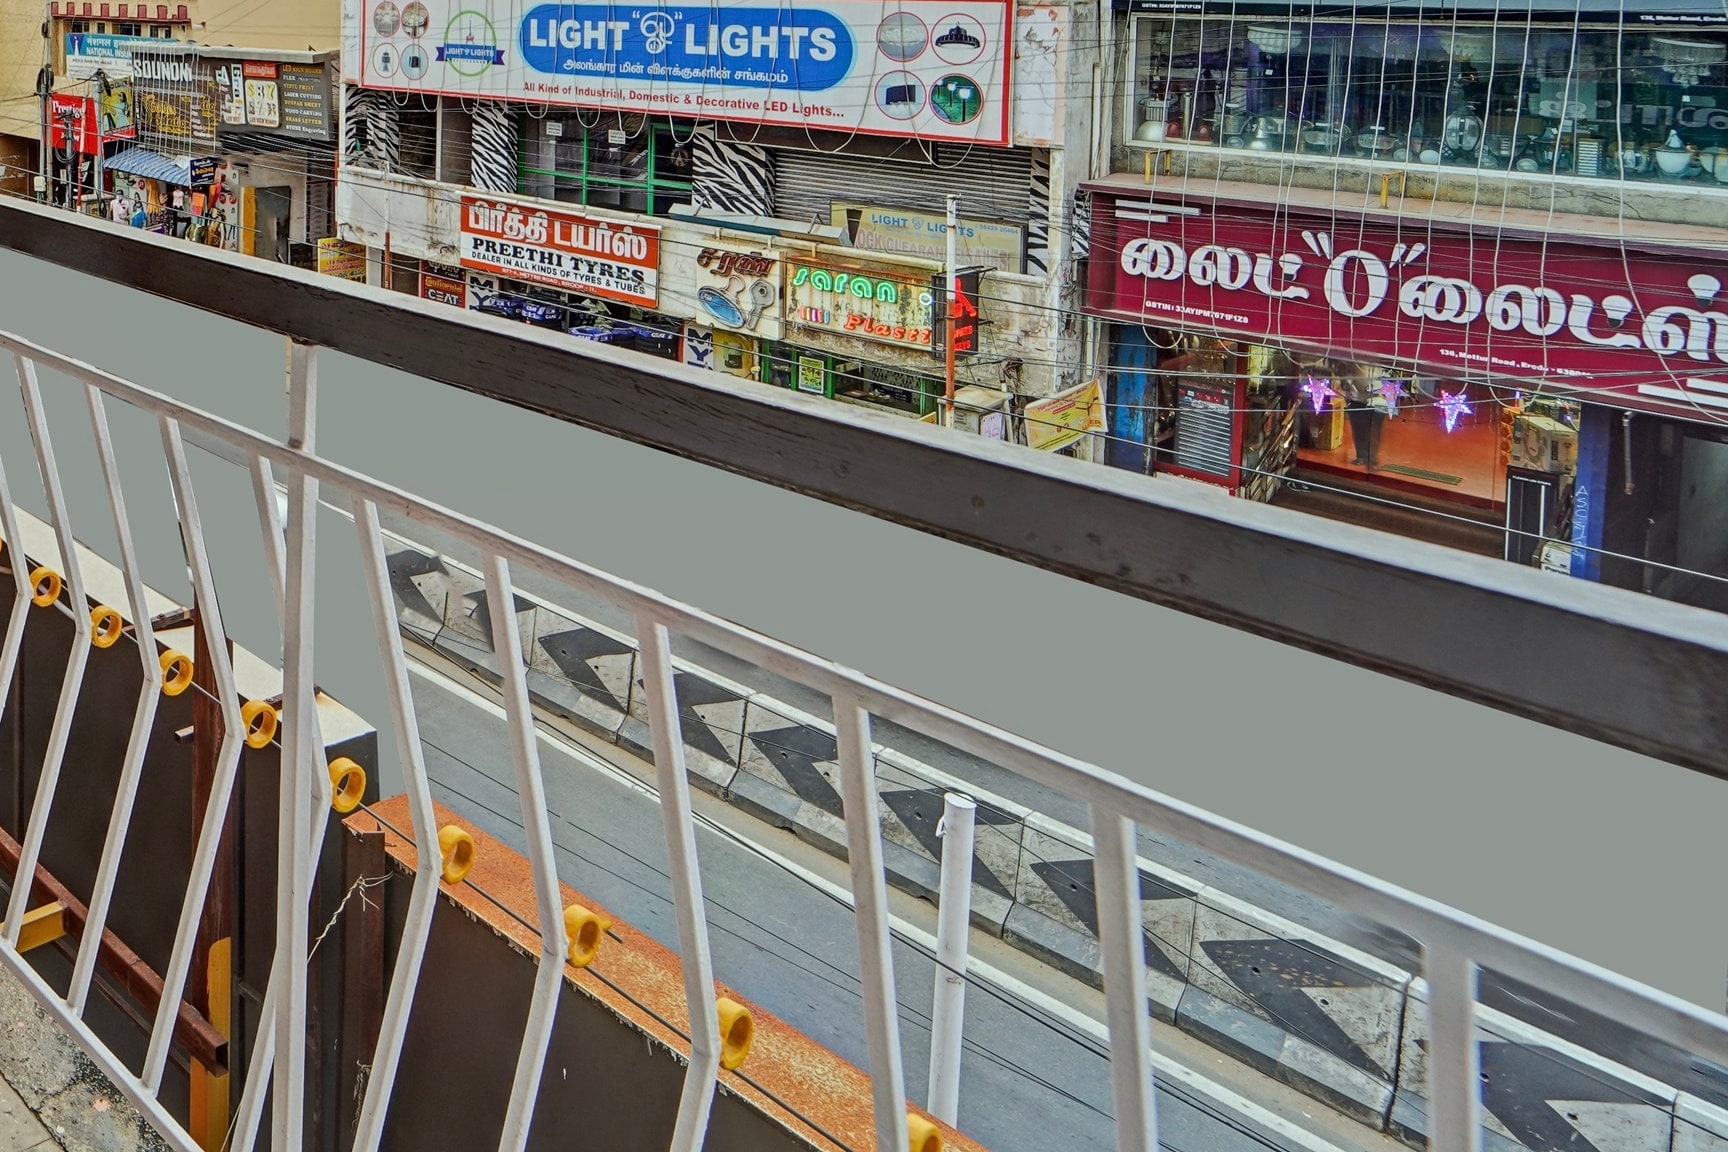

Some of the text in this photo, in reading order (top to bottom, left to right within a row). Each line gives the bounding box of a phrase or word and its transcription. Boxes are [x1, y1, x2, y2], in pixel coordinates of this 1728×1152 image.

[530, 19, 630, 51] LIGHT
[685, 23, 837, 62] LIGHTS
[86, 47, 114, 57] NATIONAL
[619, 61, 645, 74] மின்
[523, 82, 535, 92] All
[538, 83, 559, 94] Kind
[562, 85, 572, 95] of
[576, 86, 626, 101] Industrial,
[629, 90, 680, 104] Domestic
[684, 94, 692, 105] &
[696, 95, 759, 110] Decorative
[764, 101, 788, 113] LED
[872, 214, 908, 228] LIGHT
[927, 222, 974, 238] LIGTS
[472, 237, 644, 284] PREETHI TYRES
[472, 251, 645, 295] DEALER IN ALL KINDS OF TYRES & TUBES
[428, 288, 459, 305] CEAT
[792, 266, 897, 304] saran
